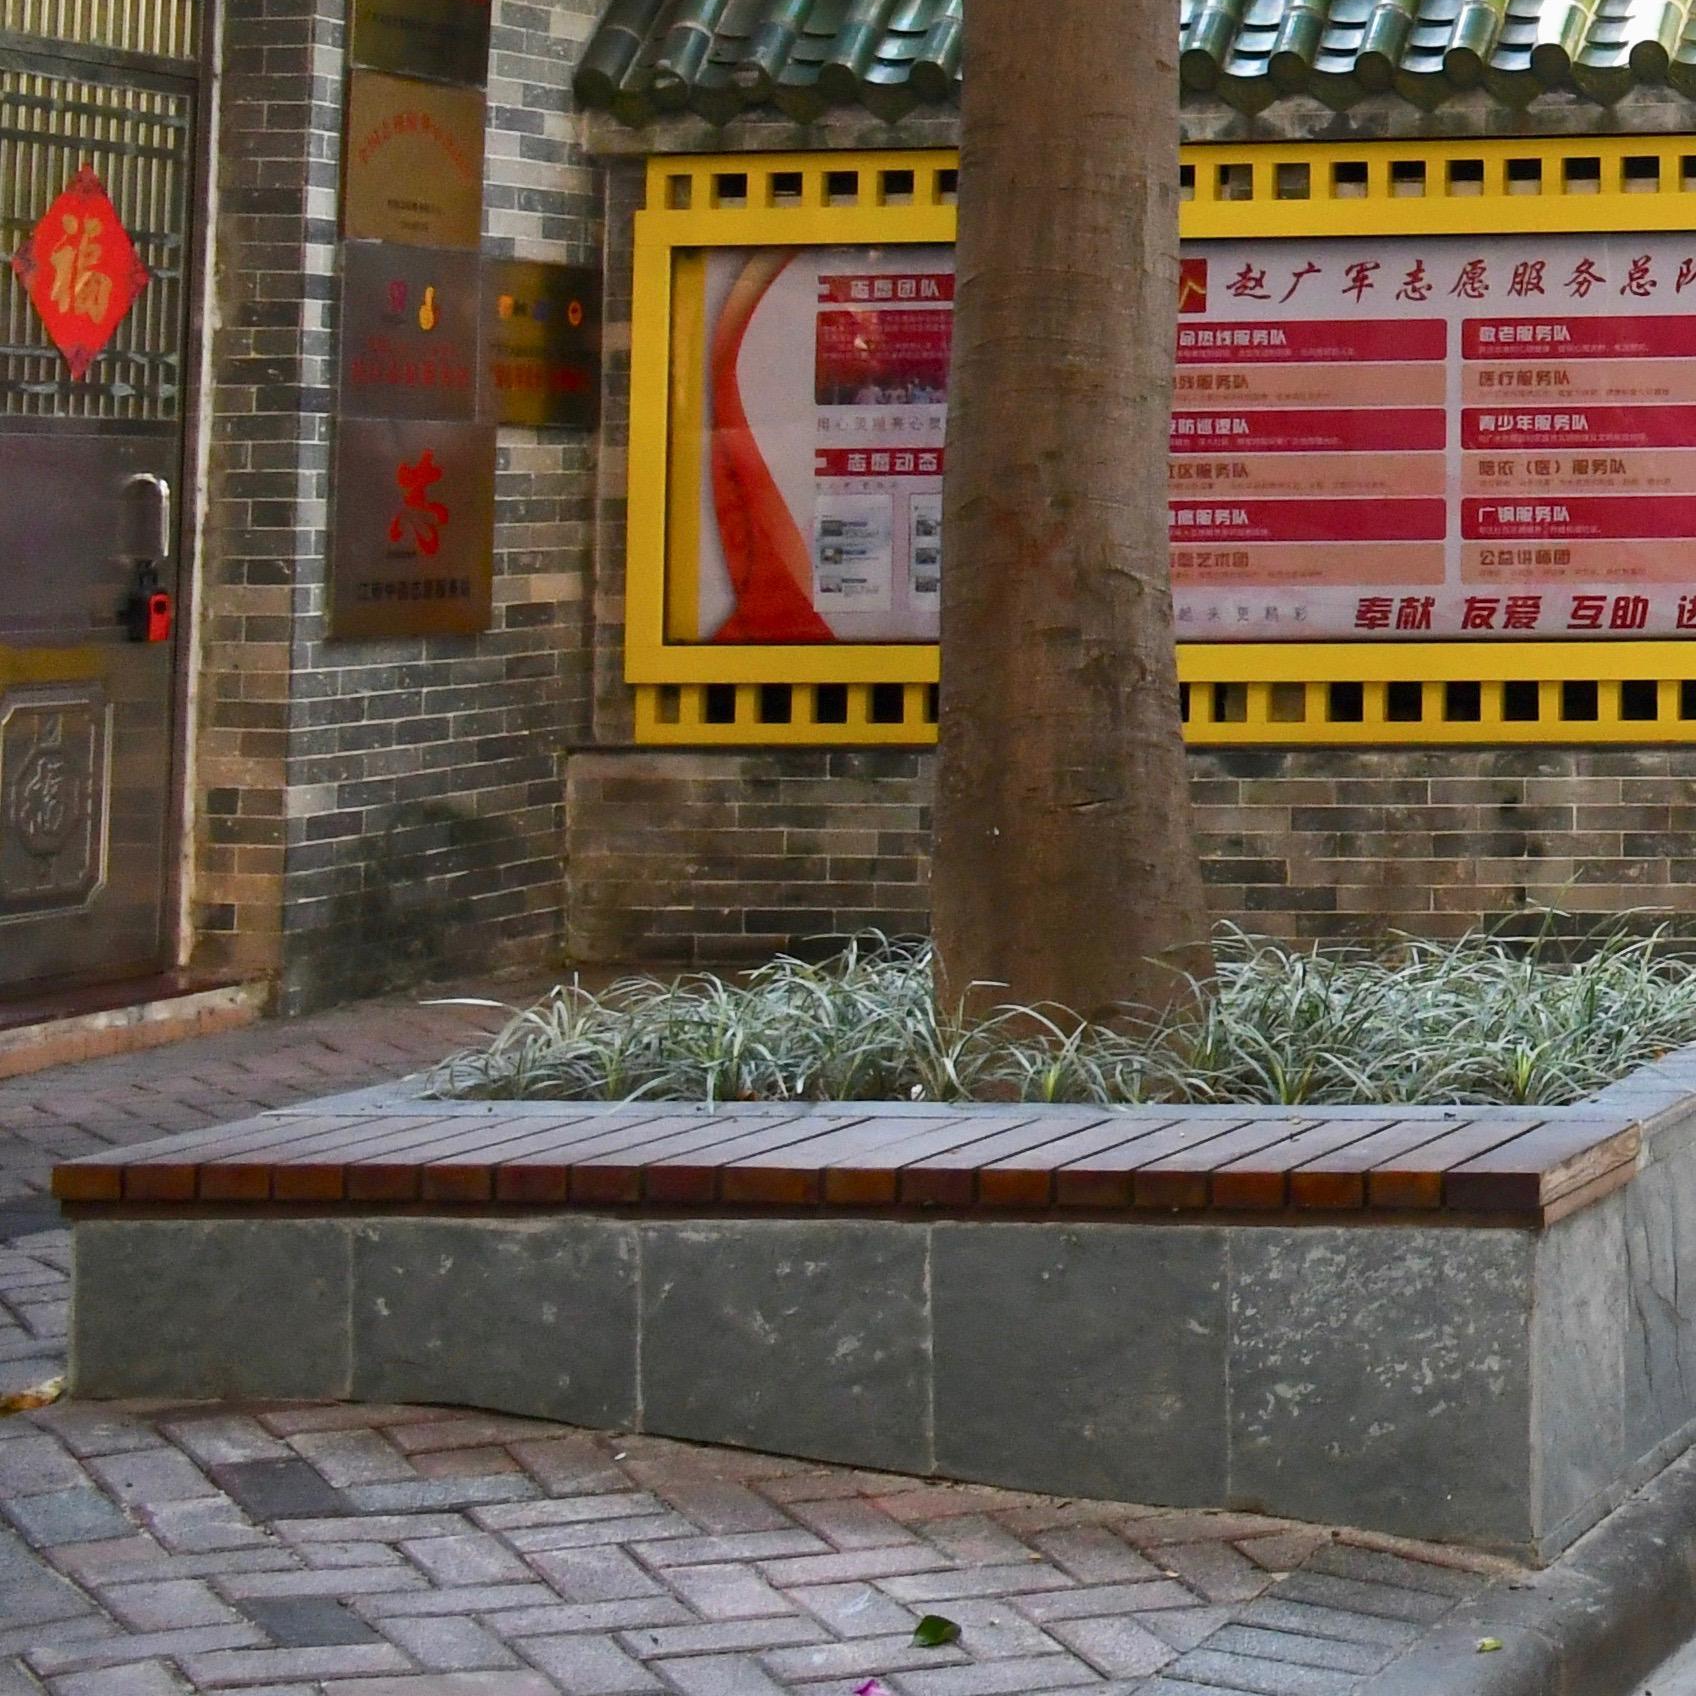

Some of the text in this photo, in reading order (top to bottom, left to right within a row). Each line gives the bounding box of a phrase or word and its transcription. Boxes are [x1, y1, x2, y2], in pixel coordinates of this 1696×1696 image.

[50, 213, 113, 325] 福
[850, 278, 940, 299] 志愿团队
[1478, 325, 1571, 343] 敬老服务队
[1172, 373, 1249, 391] 残服务队
[1478, 370, 1570, 387] 医疗服务队
[1478, 414, 1588, 432] 青少年服务队
[847, 453, 938, 472] 志愿动态
[1354, 595, 1436, 630] 奉献
[1460, 595, 1543, 630] 友爱
[1566, 595, 1650, 630] 互助
